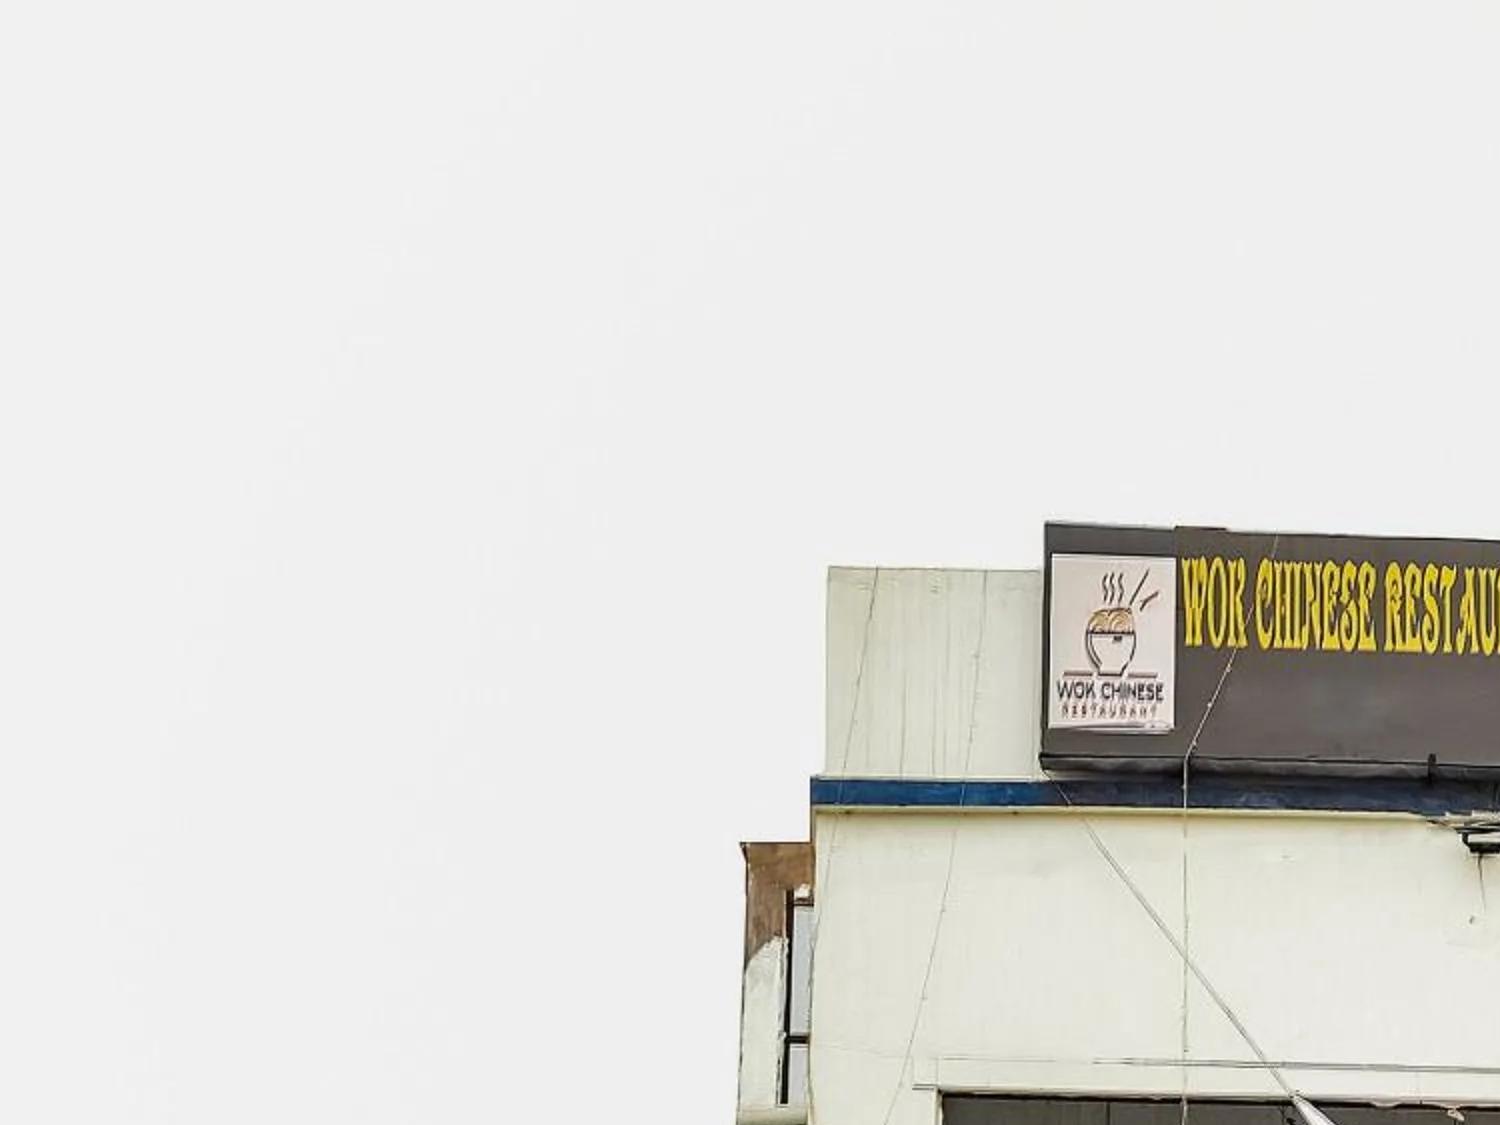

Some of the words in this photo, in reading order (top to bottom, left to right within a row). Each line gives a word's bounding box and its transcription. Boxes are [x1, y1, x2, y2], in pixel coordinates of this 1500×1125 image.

[1181, 555, 1248, 649] WOK
[1255, 556, 1378, 653] CHINESE
[1057, 680, 1096, 700] WOK
[1101, 682, 1164, 701] CHINESE
[1062, 703, 1157, 719] RESTAURANT
